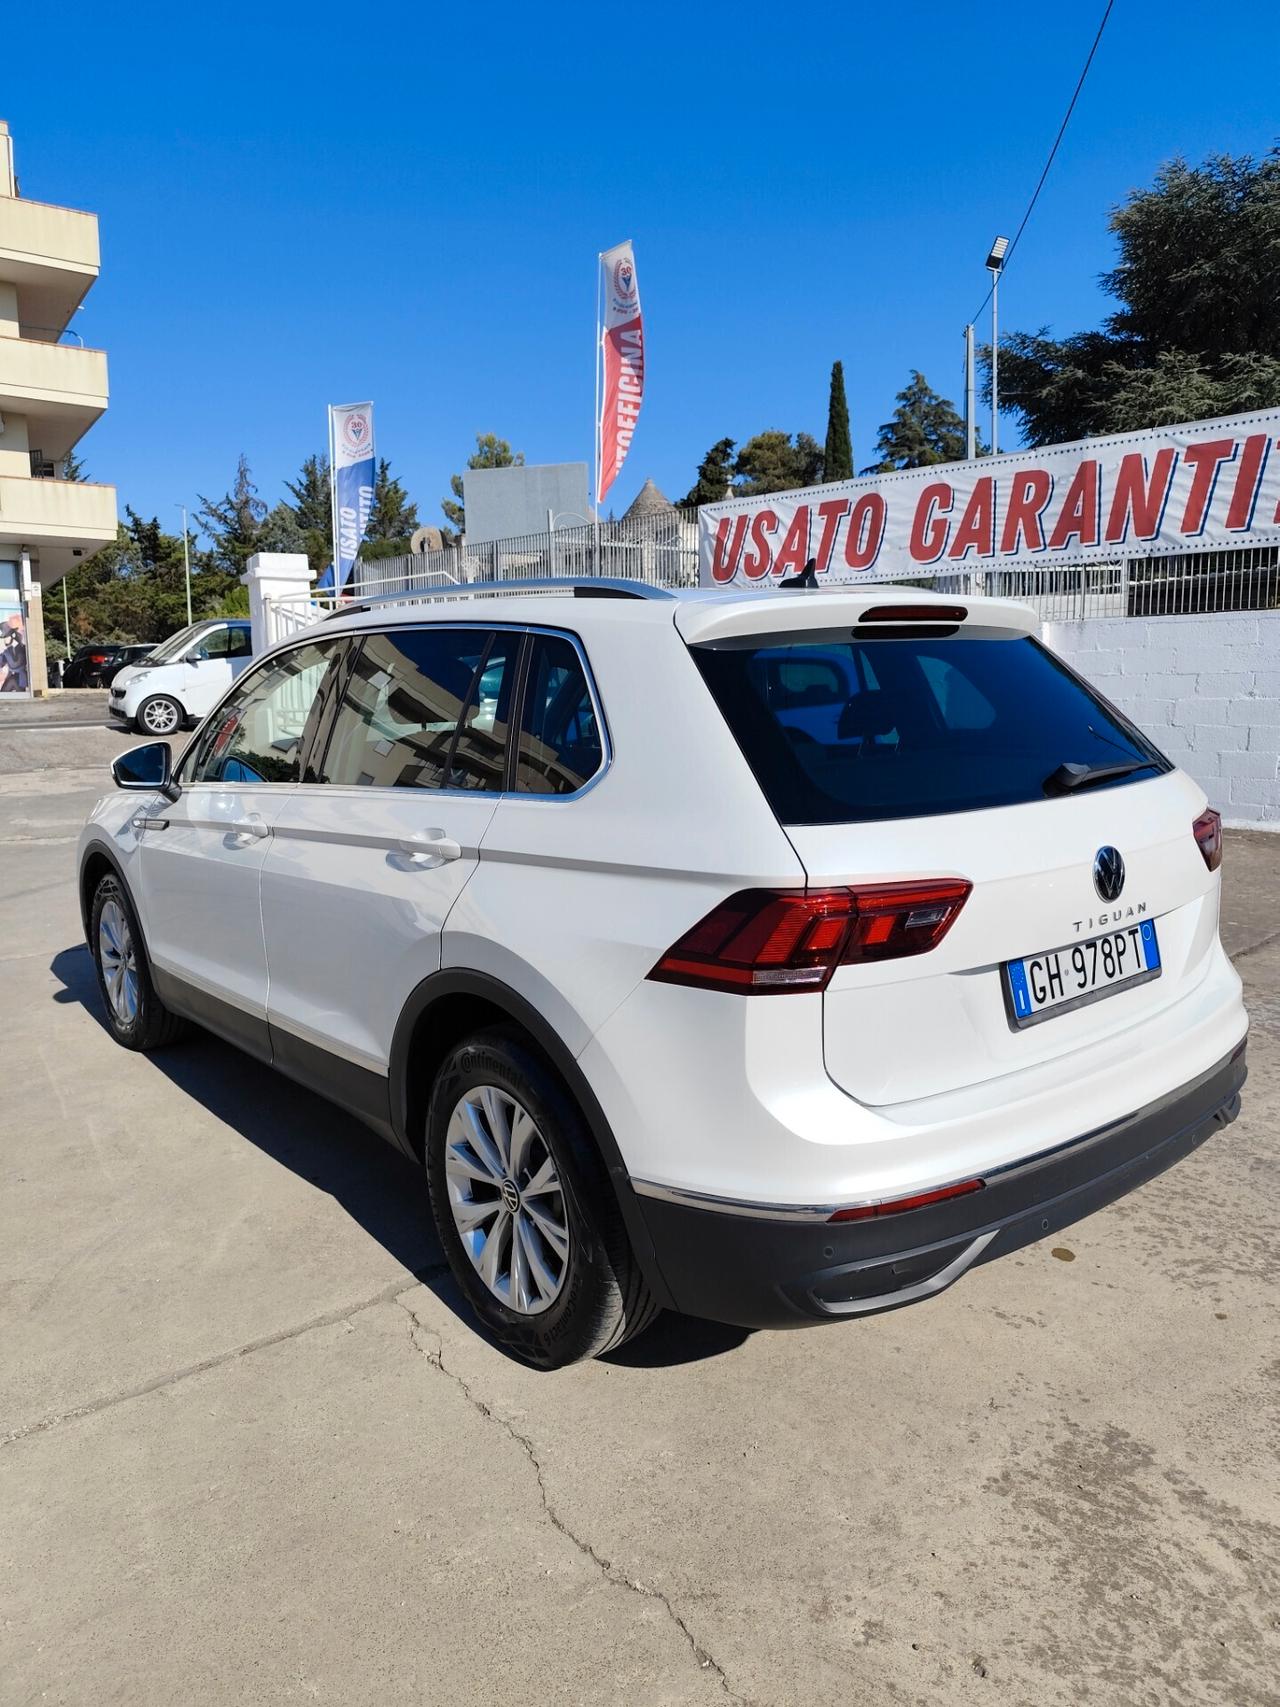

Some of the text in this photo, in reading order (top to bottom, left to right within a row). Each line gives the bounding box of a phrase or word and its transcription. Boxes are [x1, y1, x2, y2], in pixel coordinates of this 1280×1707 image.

[339, 506, 358, 561] USATO
[710, 433, 1280, 584] USATO GARANTI
[1072, 902, 1148, 933] TIGUAN
[1029, 954, 1065, 1004] GH
[1071, 928, 1142, 989] 978PT
